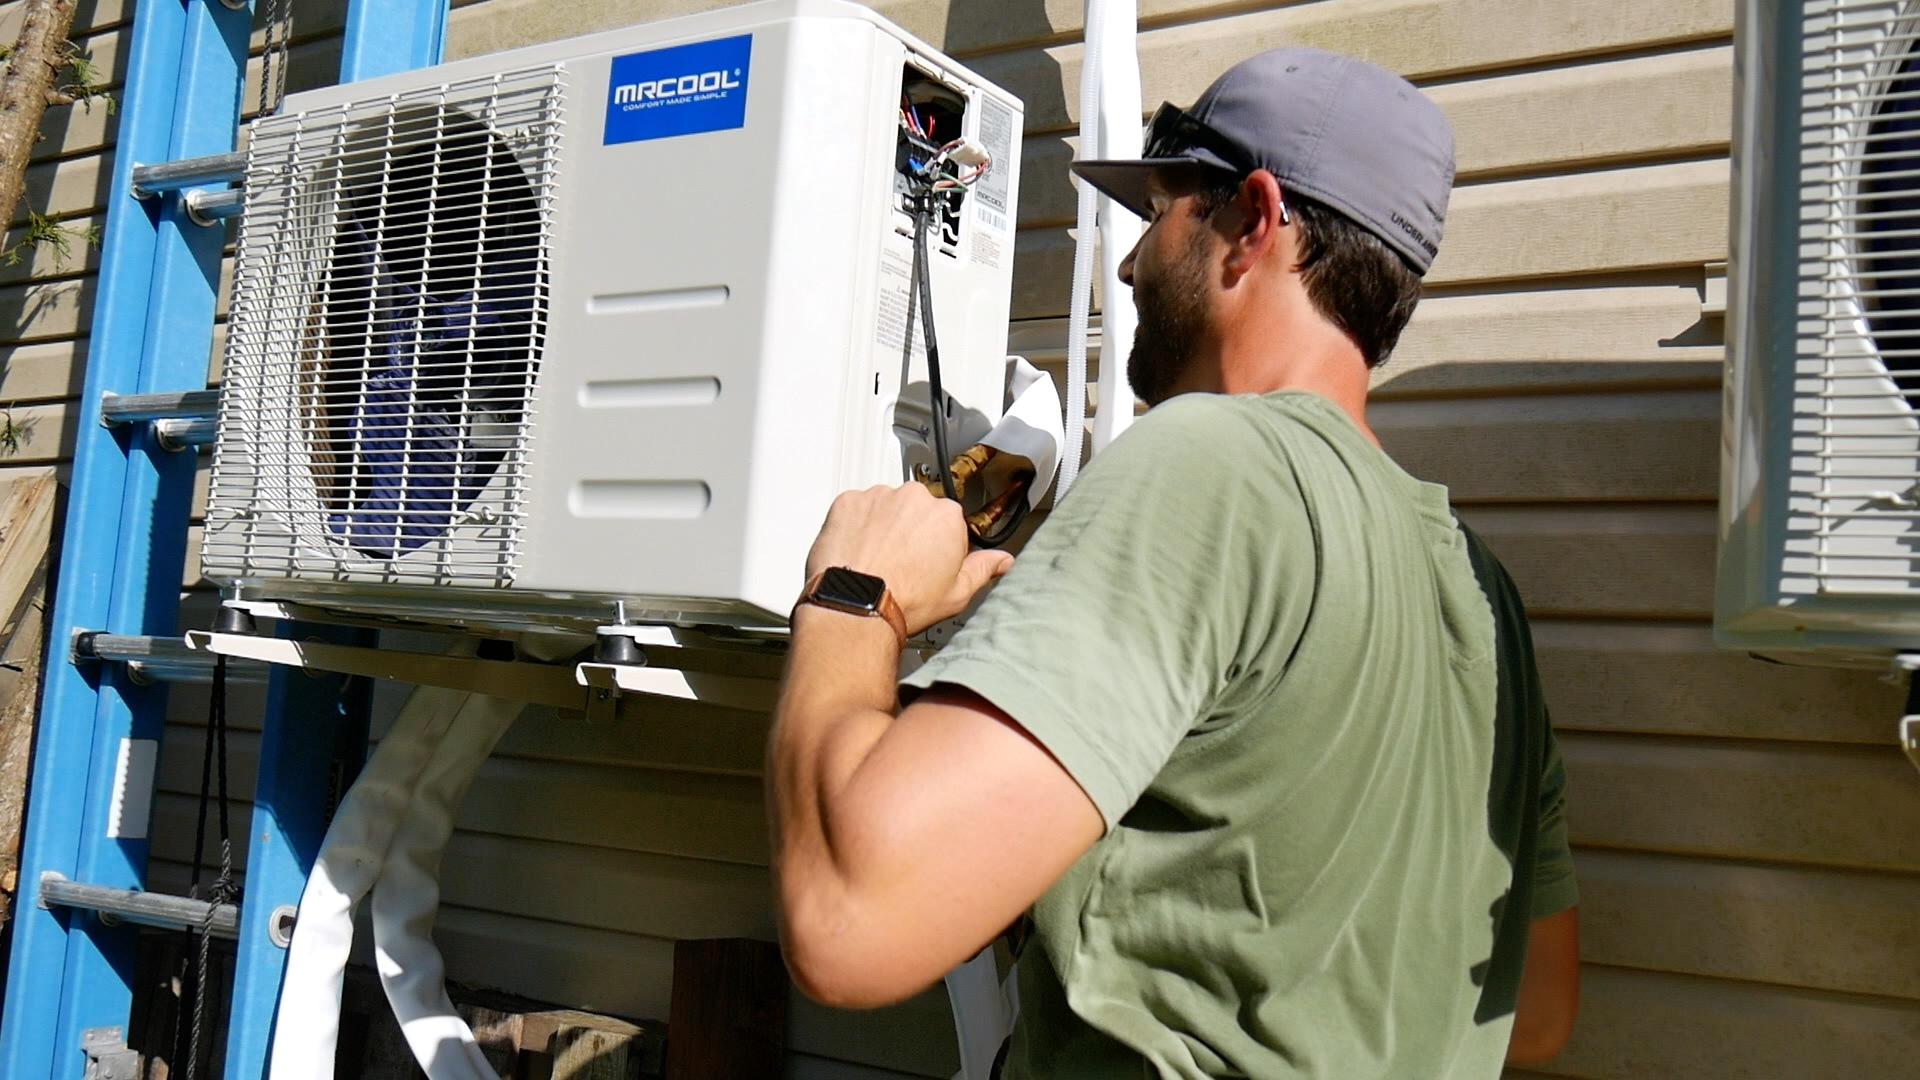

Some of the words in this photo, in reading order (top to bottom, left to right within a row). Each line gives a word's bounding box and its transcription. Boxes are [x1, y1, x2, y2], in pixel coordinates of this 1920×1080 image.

[622, 100, 665, 112] COMFORT
[666, 96, 693, 106] MADE
[693, 91, 728, 102] SIMPLE
[1391, 212, 1424, 243] UNDER
